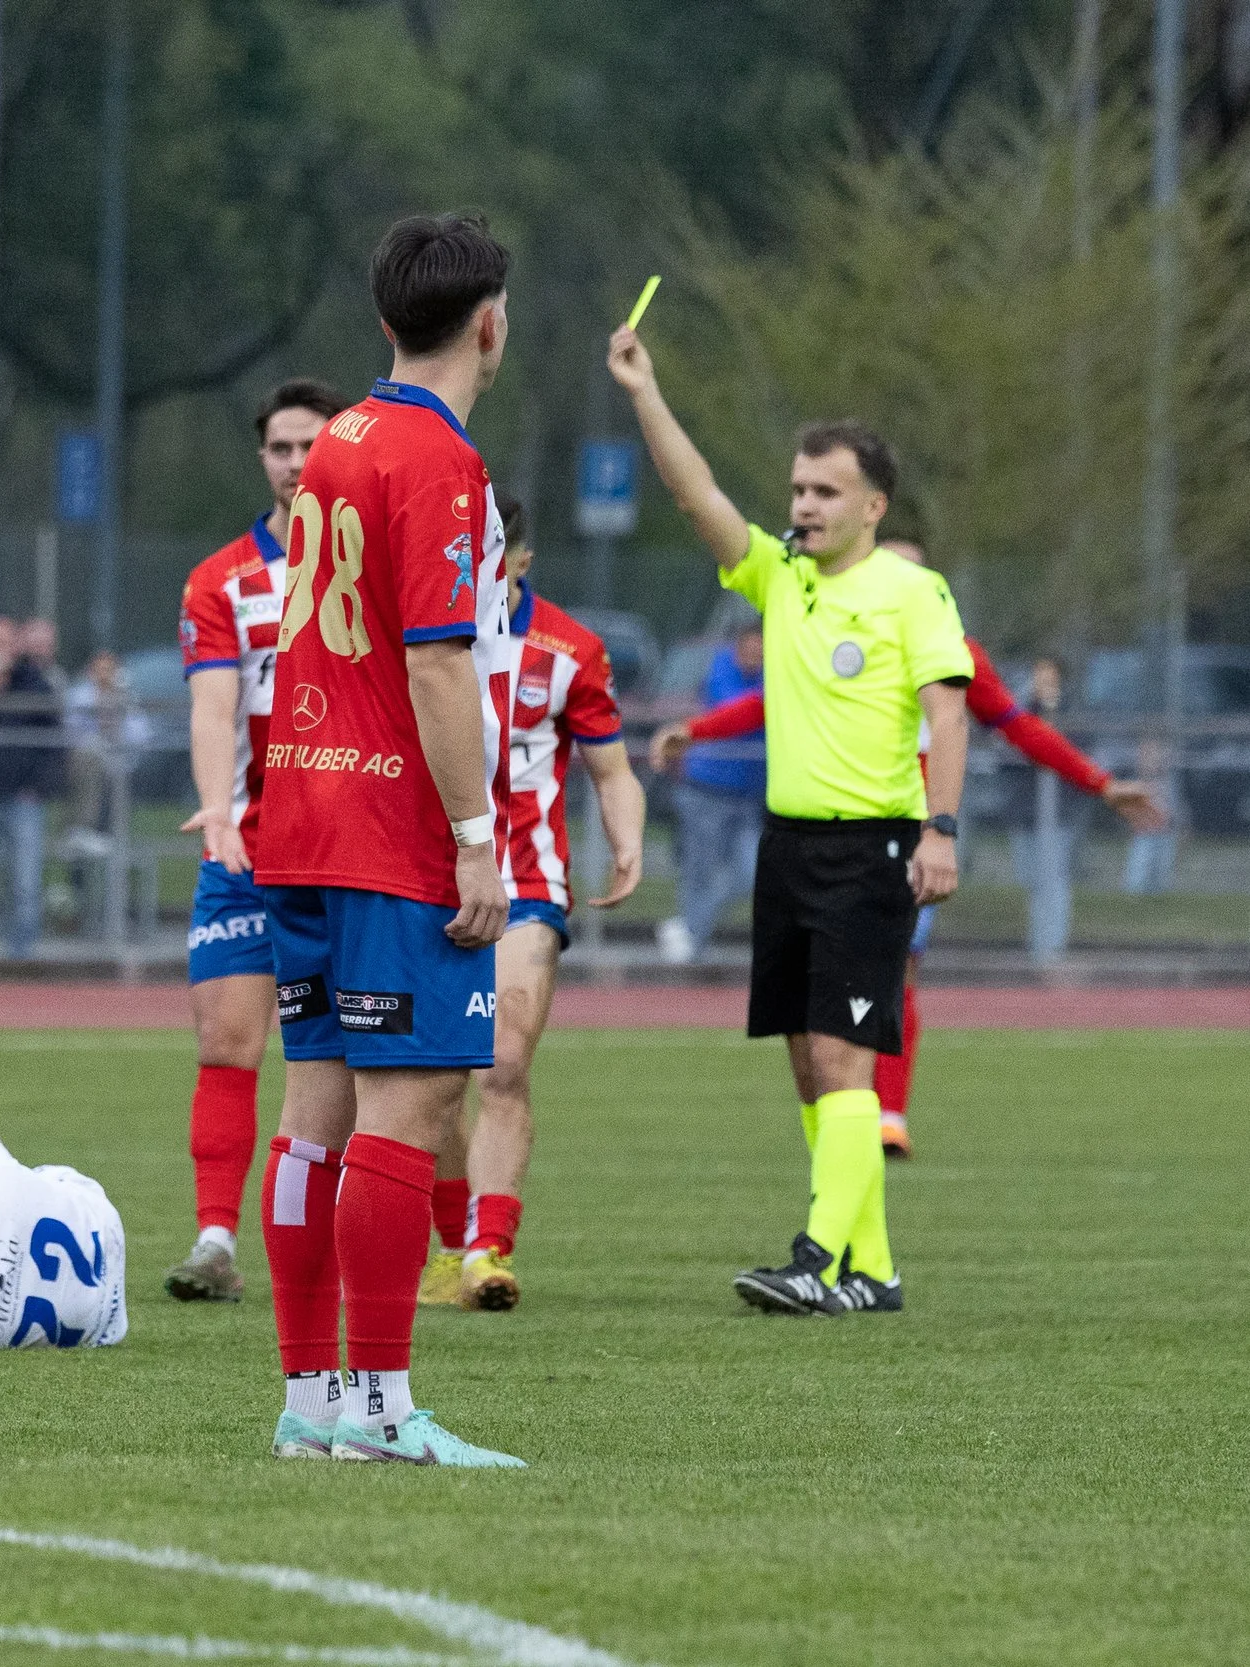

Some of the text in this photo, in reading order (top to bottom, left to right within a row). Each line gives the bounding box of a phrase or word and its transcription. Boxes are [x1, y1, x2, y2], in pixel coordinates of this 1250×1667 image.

[328, 409, 379, 444] UKAJ
[277, 484, 373, 664] 98
[361, 753, 404, 779] AG
[369, 1396, 383, 1414] FS
